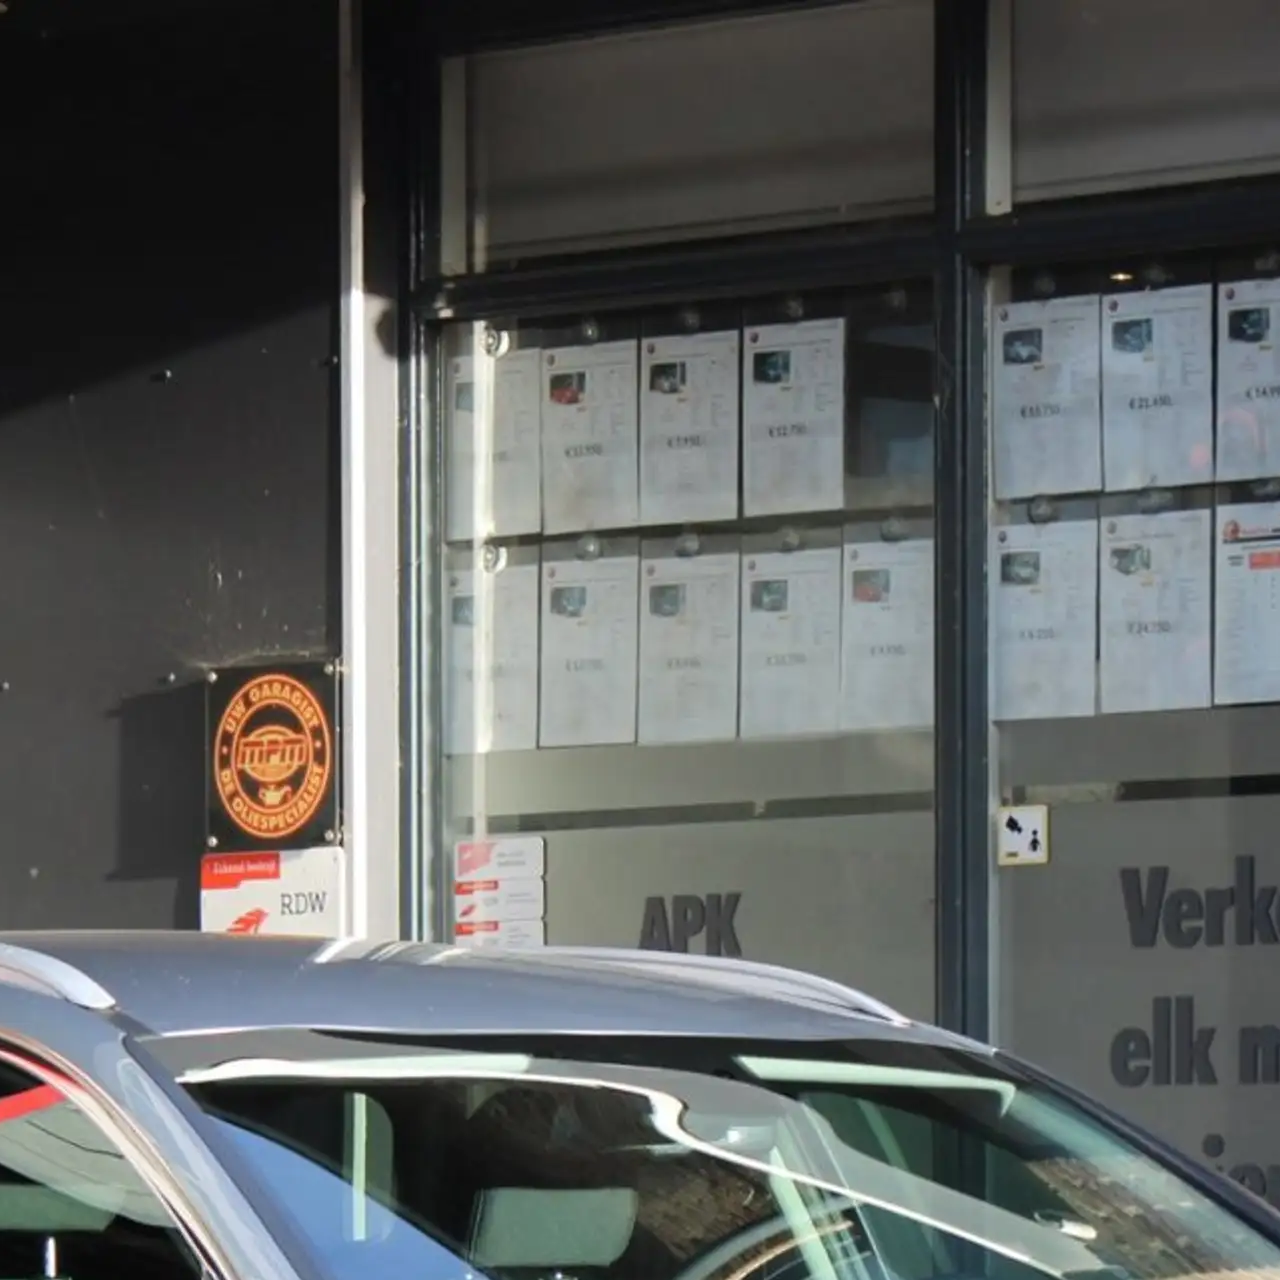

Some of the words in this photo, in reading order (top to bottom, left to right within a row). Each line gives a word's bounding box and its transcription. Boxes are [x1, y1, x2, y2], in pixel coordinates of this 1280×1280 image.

[248, 681, 321, 729] GARAGIST
[280, 891, 327, 916] RDW
[638, 892, 742, 957] APK
[1110, 995, 1218, 1088] elk
